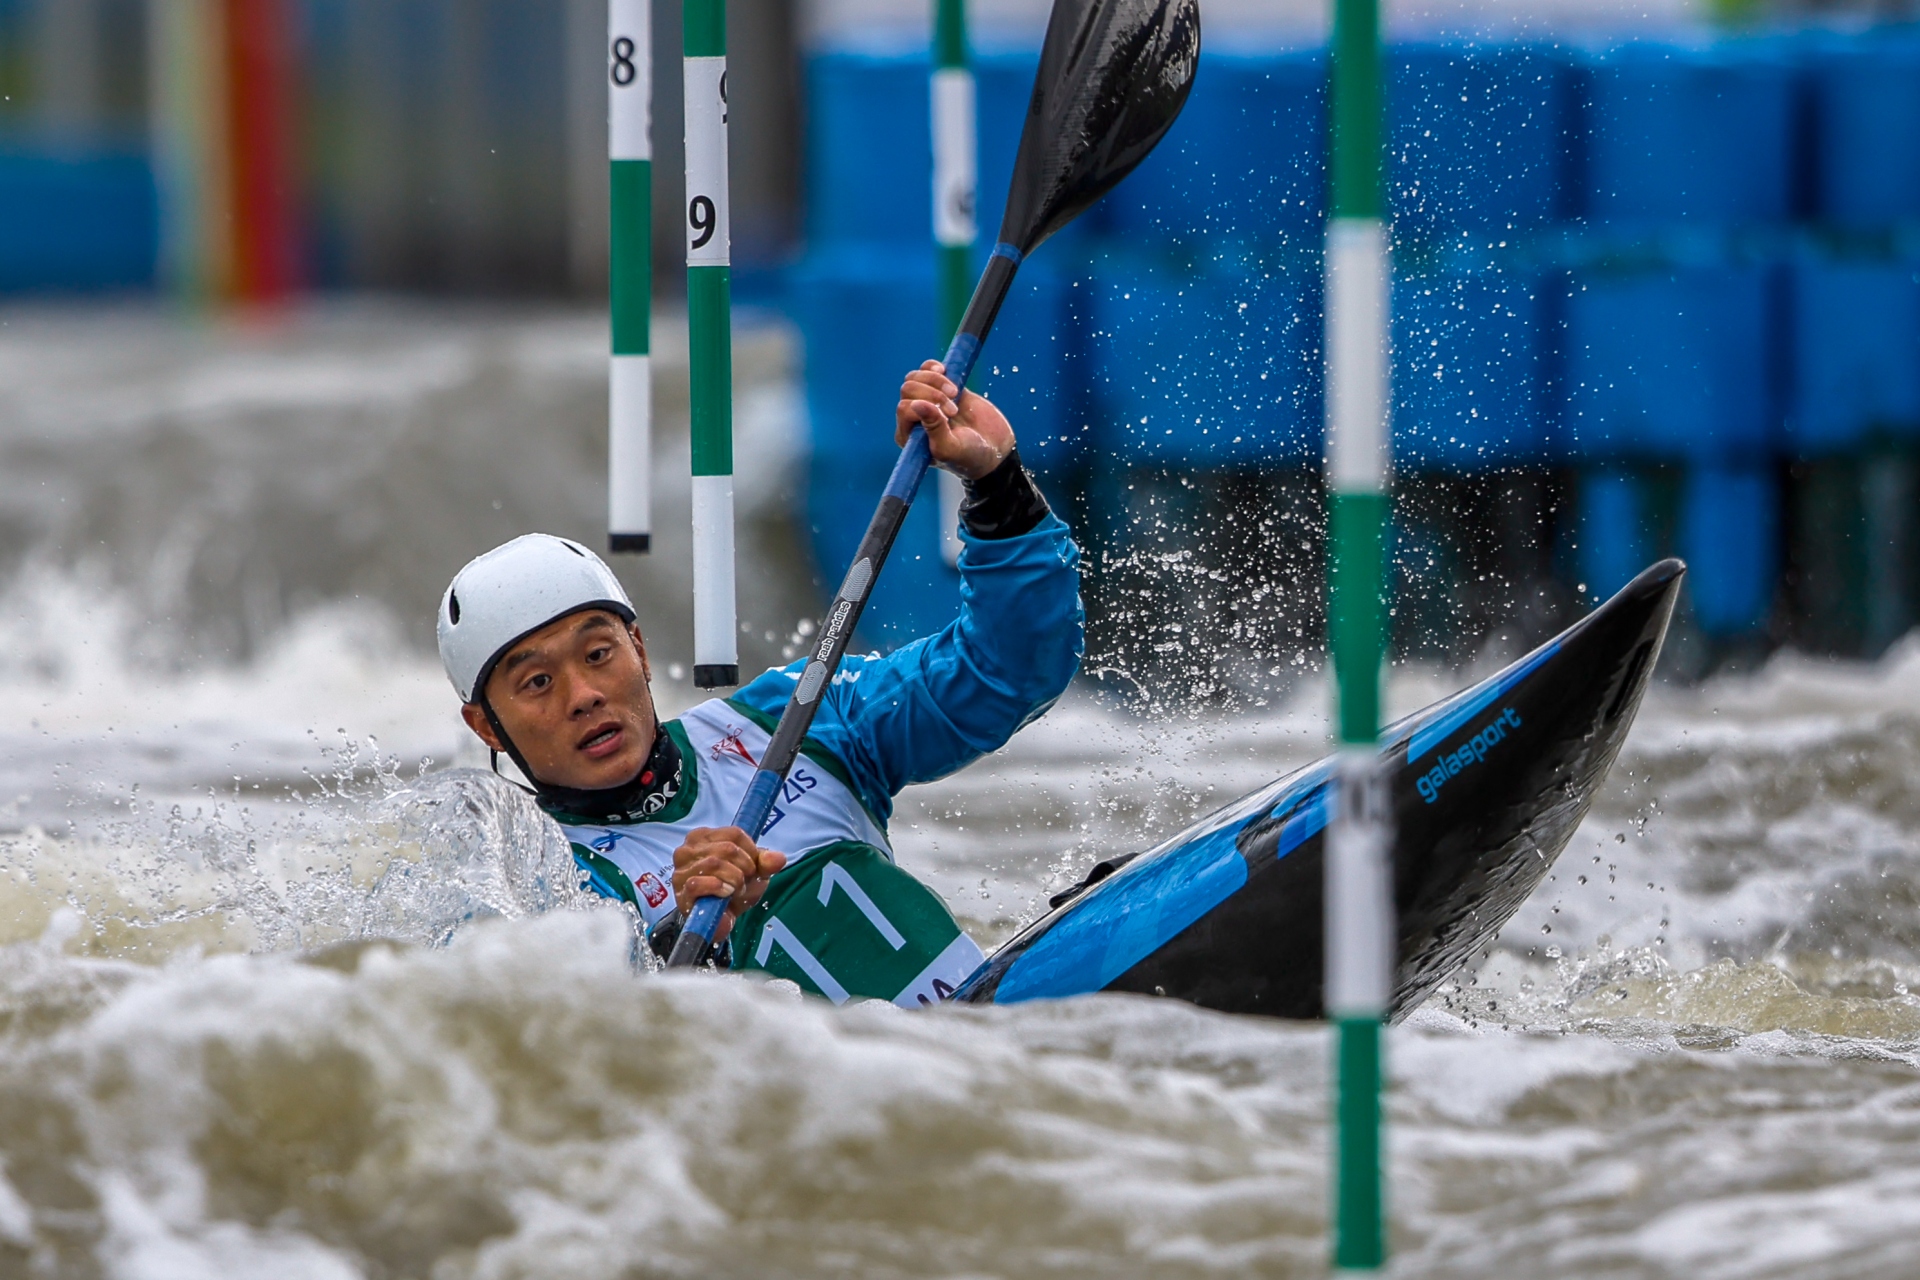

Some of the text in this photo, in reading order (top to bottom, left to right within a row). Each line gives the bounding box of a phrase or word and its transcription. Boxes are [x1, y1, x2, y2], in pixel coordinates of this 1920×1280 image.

[612, 37, 636, 86] 8
[688, 195, 716, 250] 9
[817, 600, 852, 661] raab paddles
[1416, 707, 1522, 804] galasport
[782, 768, 818, 804] ZIS
[754, 861, 906, 1006] 11
